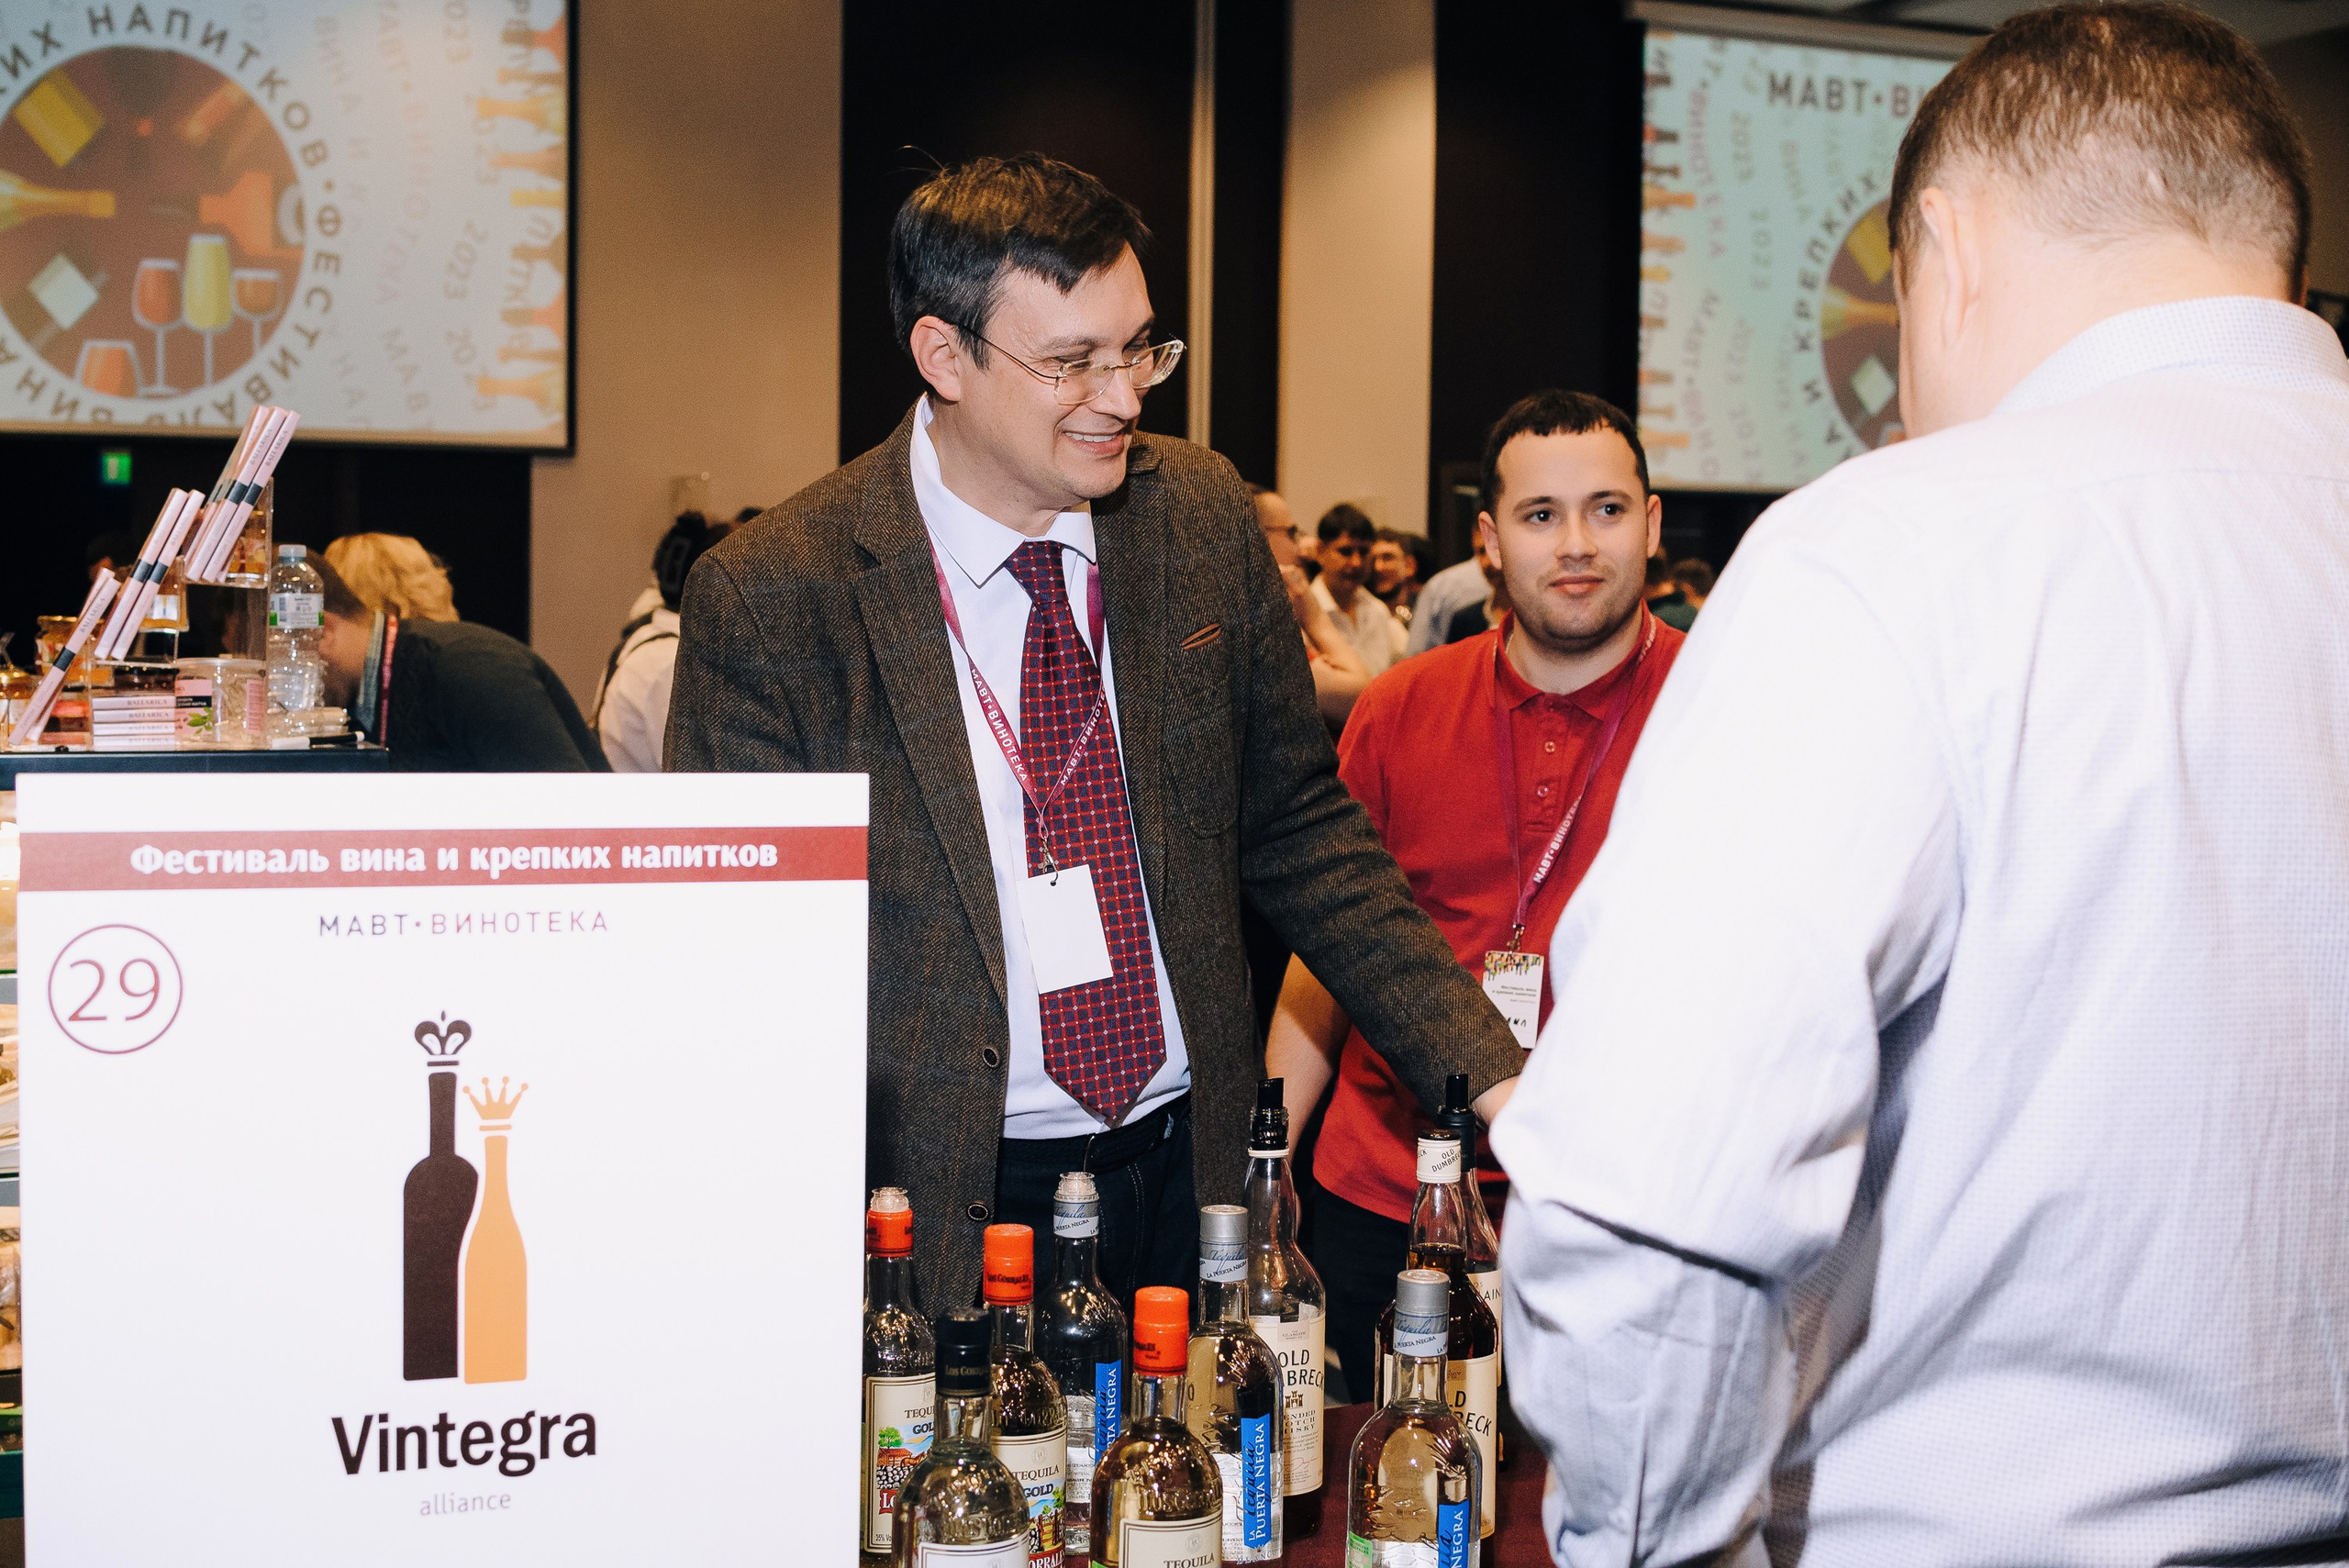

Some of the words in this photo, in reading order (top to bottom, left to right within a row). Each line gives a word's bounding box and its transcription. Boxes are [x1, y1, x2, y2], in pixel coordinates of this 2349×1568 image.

[0, 20, 62, 95] ИХ
[87, 4, 328, 169] НАПИТКОВ
[1766, 70, 1925, 118] МАВТ•В
[1059, 686, 1107, 787] МАВТ•ВИНОТЕ
[130, 842, 329, 875] Фестиваль
[340, 847, 427, 873] вина
[438, 847, 459, 872] и
[471, 845, 611, 879] крепких
[622, 844, 778, 869] напитков
[67, 957, 161, 1022] 29
[1442, 1149, 1454, 1159] OLD
[1277, 1349, 1310, 1368] OLD
[1106, 1367, 1117, 1419] NEGRA
[904, 1405, 935, 1419] TEQU
[1283, 1409, 1317, 1420] ENDED
[1285, 1417, 1316, 1428] OTCH
[912, 1420, 935, 1435] GOL
[1107, 1422, 1117, 1449] RTA
[1285, 1423, 1316, 1434] ISKY
[331, 1410, 596, 1478] Vintegra
[1254, 1423, 1266, 1477] NEGRA
[1012, 1464, 1060, 1481] TEQUILA
[1023, 1483, 1054, 1498] GOLD
[419, 1492, 511, 1517] alliance
[1255, 1482, 1266, 1540] PUERTA
[1249, 1529, 1256, 1541] LA
[1163, 1552, 1215, 1568] TEQUILA
